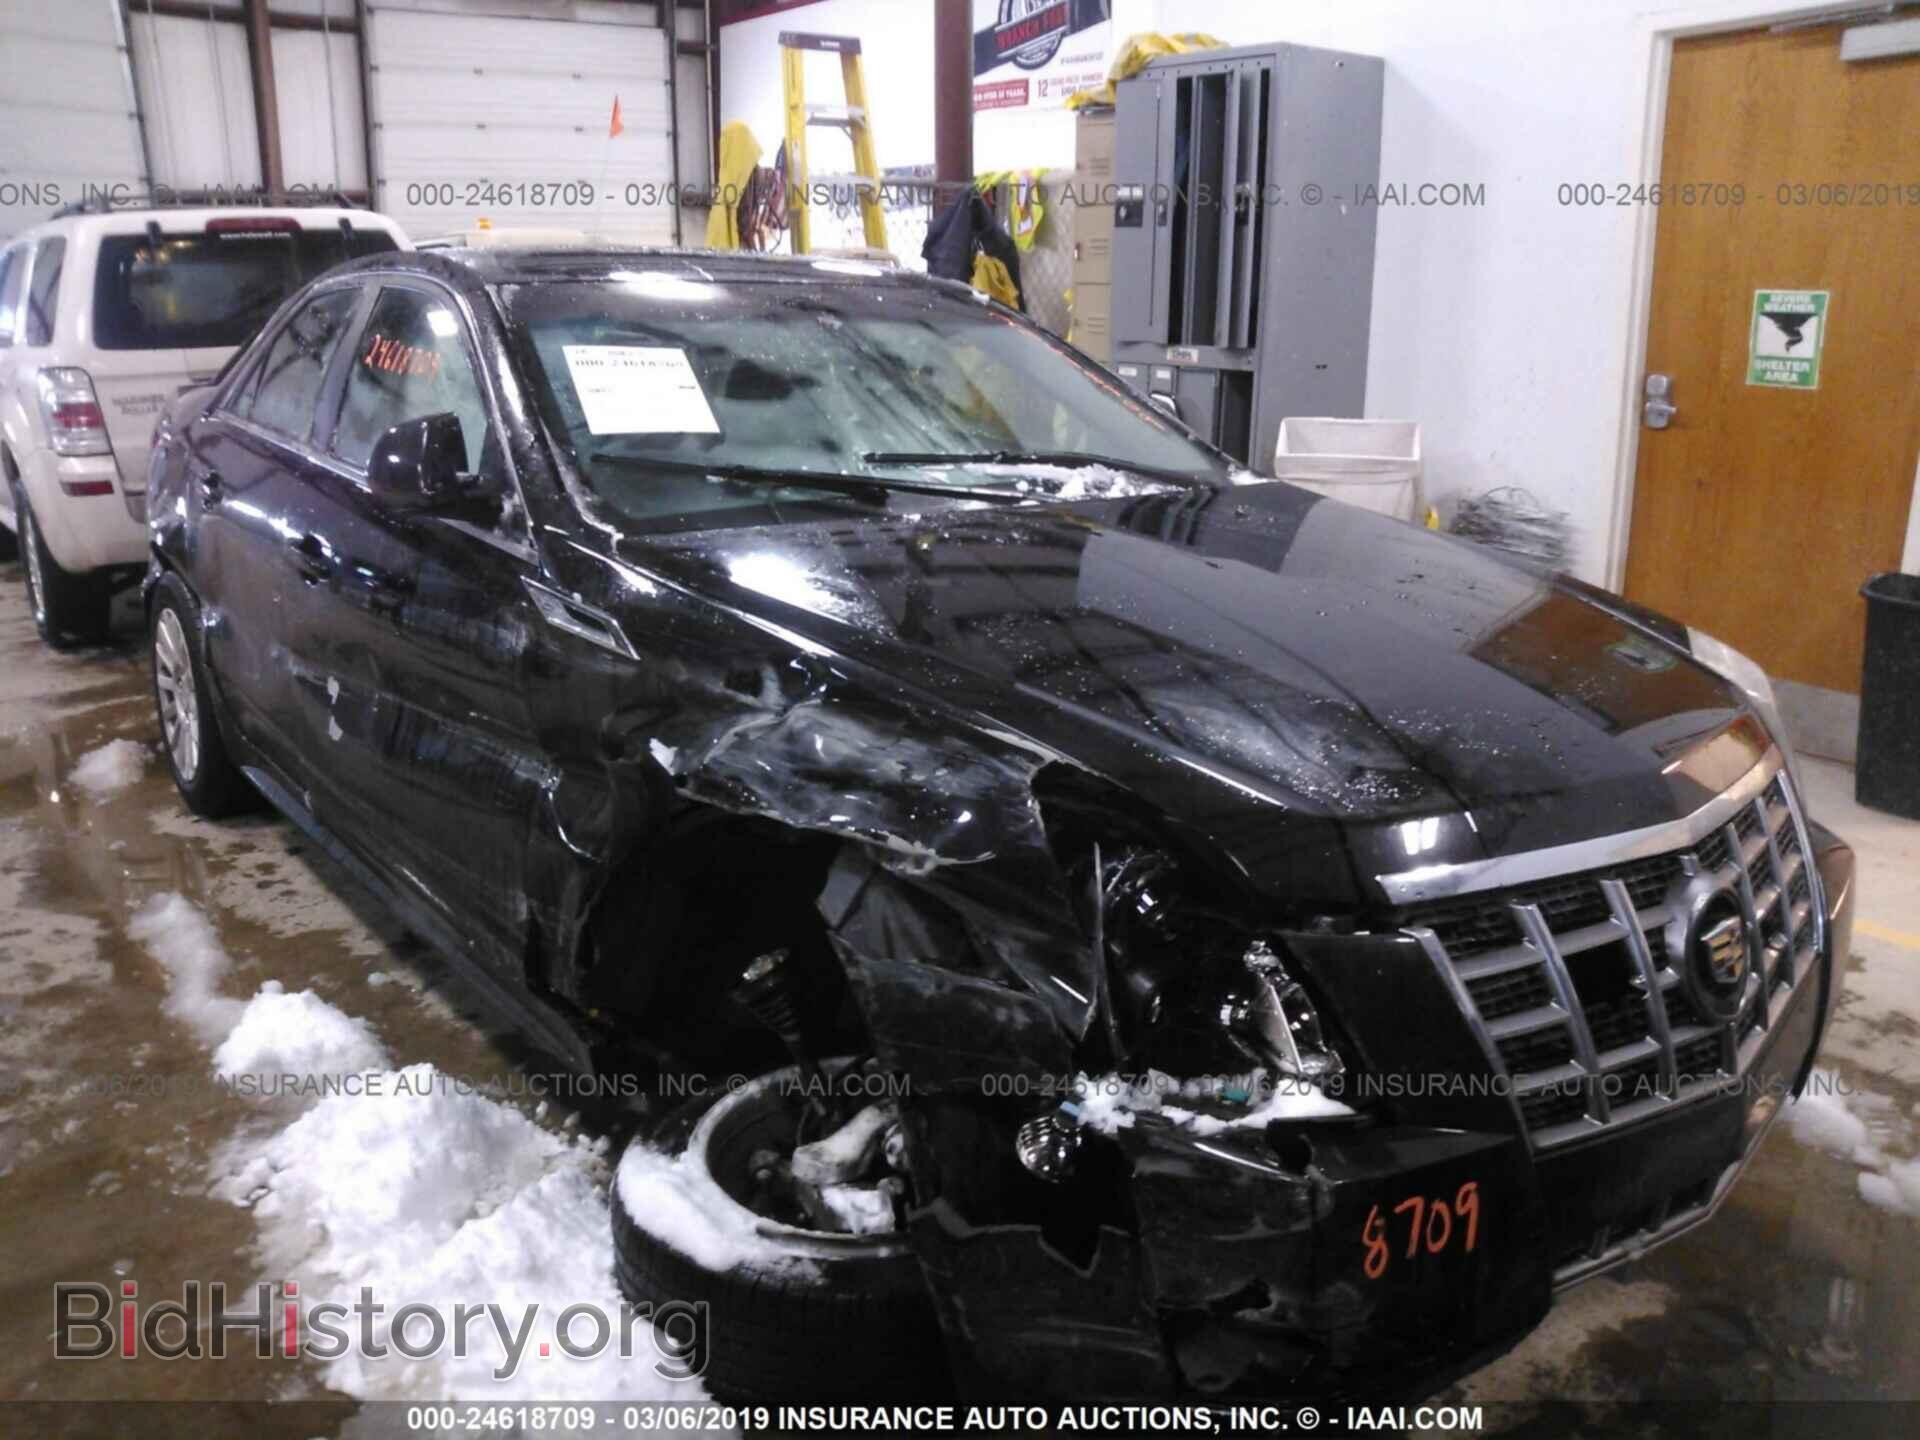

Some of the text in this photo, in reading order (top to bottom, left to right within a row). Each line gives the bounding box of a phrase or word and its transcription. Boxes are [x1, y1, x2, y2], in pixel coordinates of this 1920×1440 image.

[1763, 303, 1816, 313] WEATHER
[1754, 360, 1810, 373] SHELTER
[1763, 371, 1799, 383] AREA
[1362, 1182, 1479, 1279] 8709
